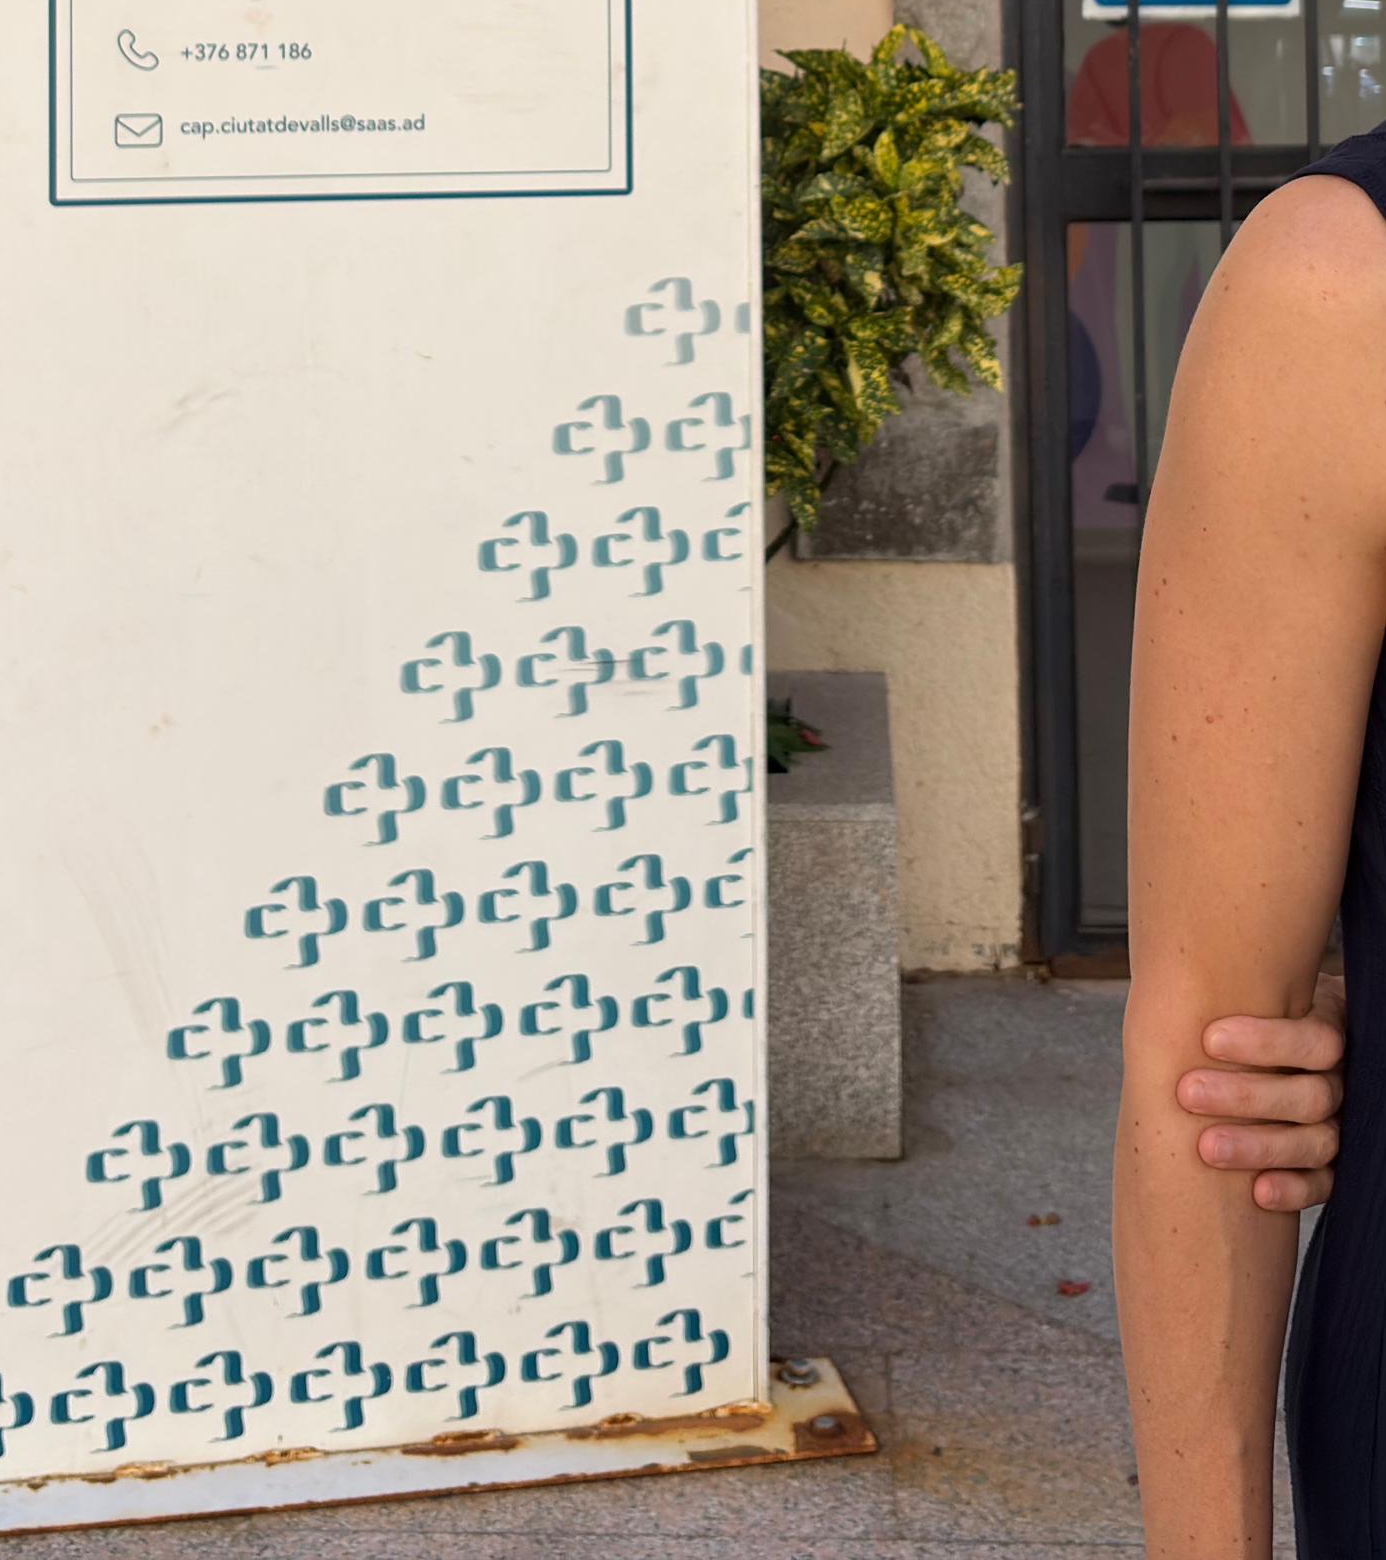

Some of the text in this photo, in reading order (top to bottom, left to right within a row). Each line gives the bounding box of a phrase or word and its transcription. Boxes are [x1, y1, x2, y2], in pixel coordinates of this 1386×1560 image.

[181, 42, 313, 61] +376 871 186
[180, 113, 425, 141] cap.ciutatdevalls@saas.ad
